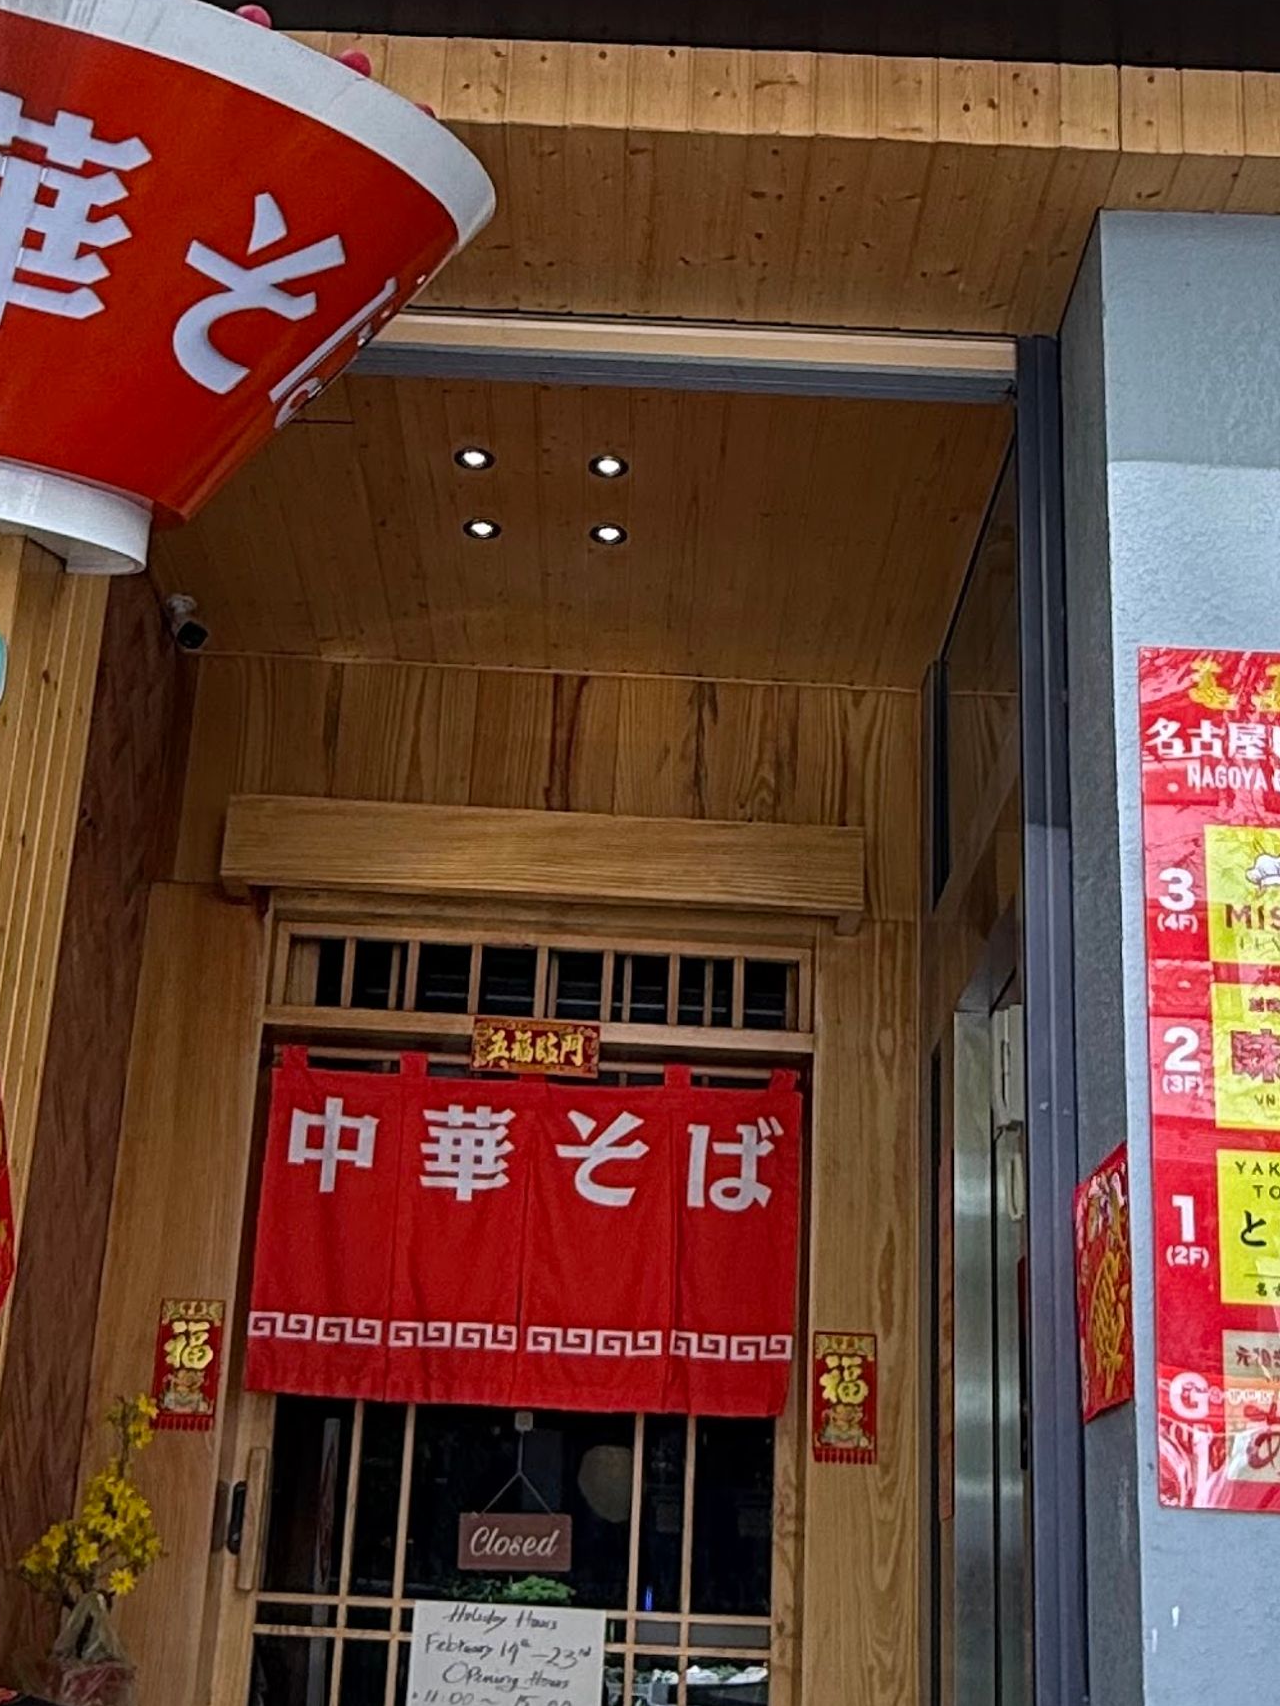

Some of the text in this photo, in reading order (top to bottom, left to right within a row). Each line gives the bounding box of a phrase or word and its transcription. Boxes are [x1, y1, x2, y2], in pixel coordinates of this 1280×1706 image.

[1187, 764, 1268, 792] NAGOYA
[1158, 867, 1195, 911] 3
[1157, 913, 1199, 934] (4F)
[1162, 1026, 1202, 1073] 2
[1161, 1074, 1204, 1094] (3F)
[1254, 1094, 1276, 1107] VN
[286, 1096, 786, 1213] 中華そば
[1172, 1195, 1196, 1243] 1
[1166, 1245, 1210, 1268] (2F)
[1169, 1372, 1210, 1420] G
[469, 1526, 561, 1557] Closed
[425, 1633, 494, 1660] February
